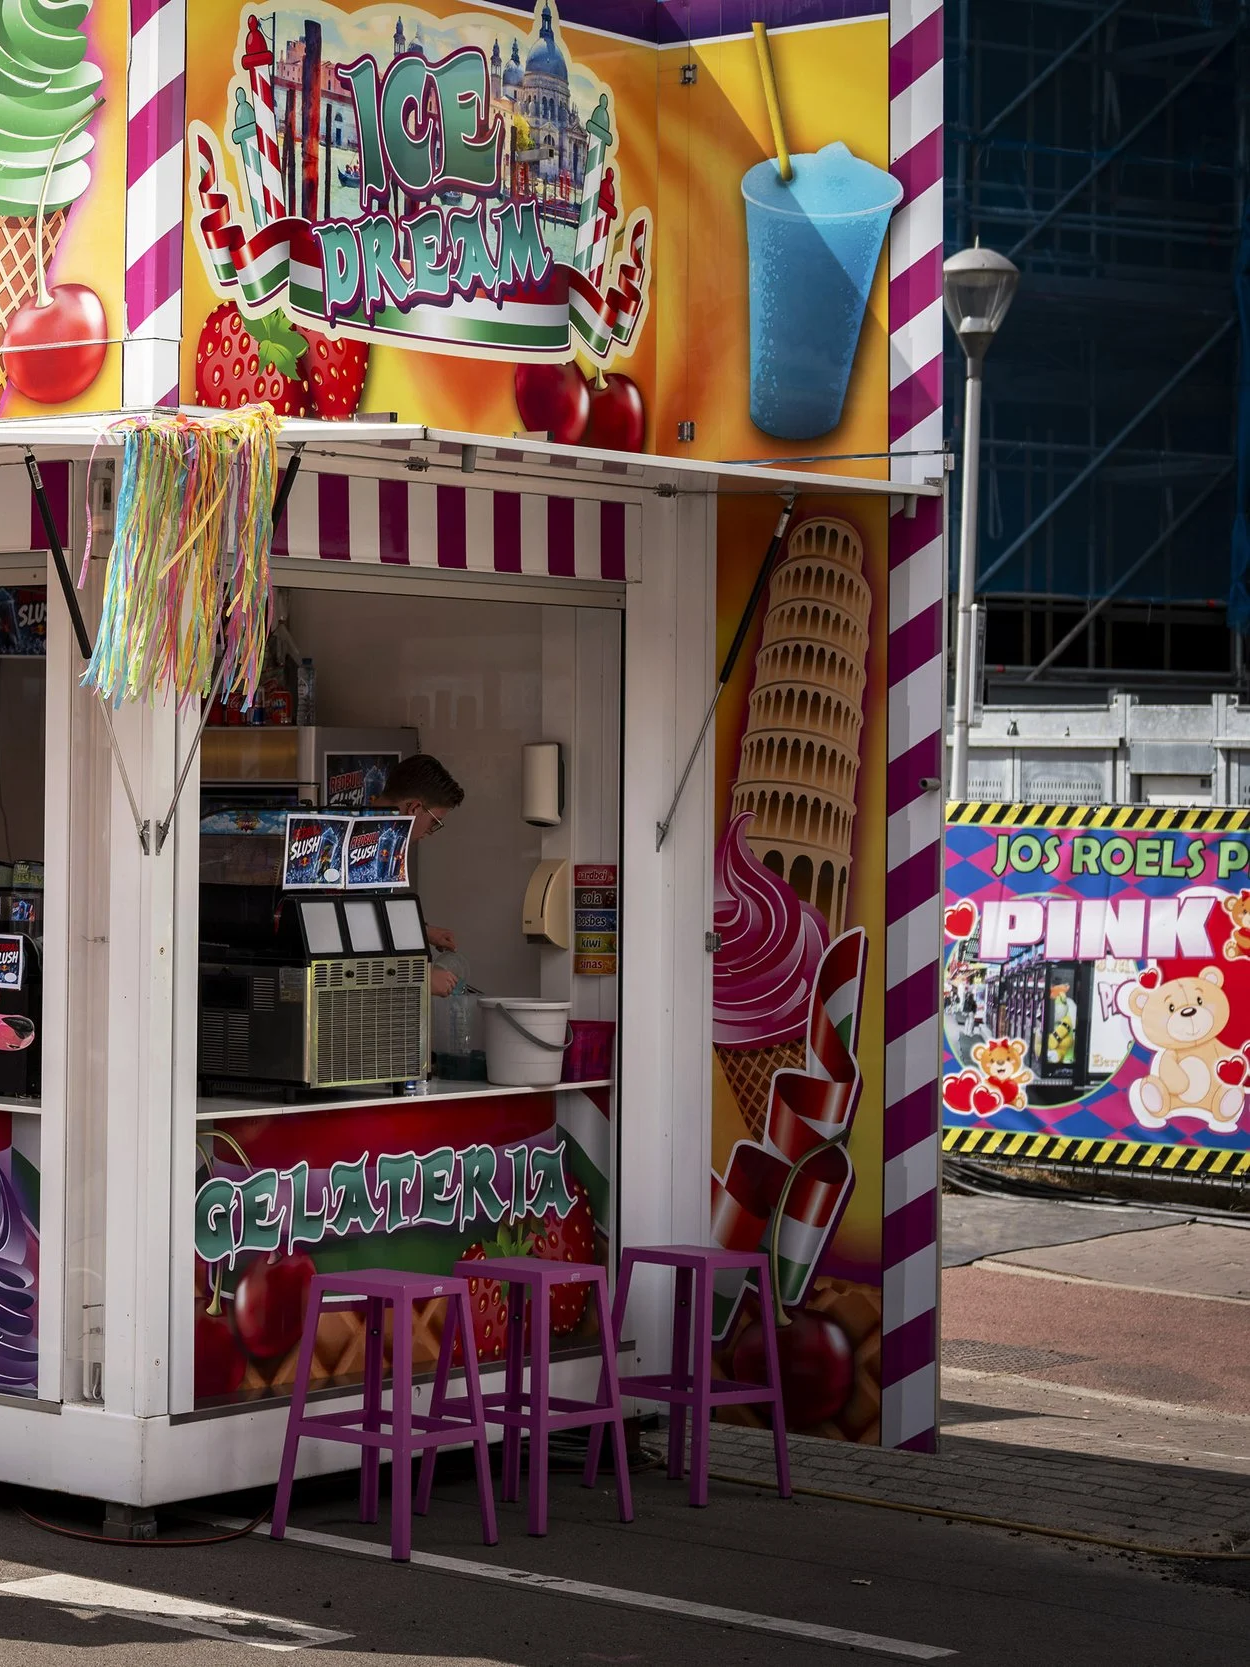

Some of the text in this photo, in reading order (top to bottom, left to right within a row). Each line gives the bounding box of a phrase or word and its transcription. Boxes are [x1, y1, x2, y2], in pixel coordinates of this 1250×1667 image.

[336, 46, 504, 206] ICE
[311, 200, 551, 319] DREAM
[289, 835, 321, 861] SLUSH
[349, 843, 379, 866] SLUSH
[991, 834, 1250, 880] JOS ROELS P
[577, 870, 608, 881] aardbei
[581, 890, 603, 904] cola
[576, 913, 607, 927] bosbes
[979, 896, 1217, 960] PINK
[581, 935, 602, 949] kiwi
[580, 959, 603, 969] sinas
[194, 1139, 578, 1271] GELATERIA
